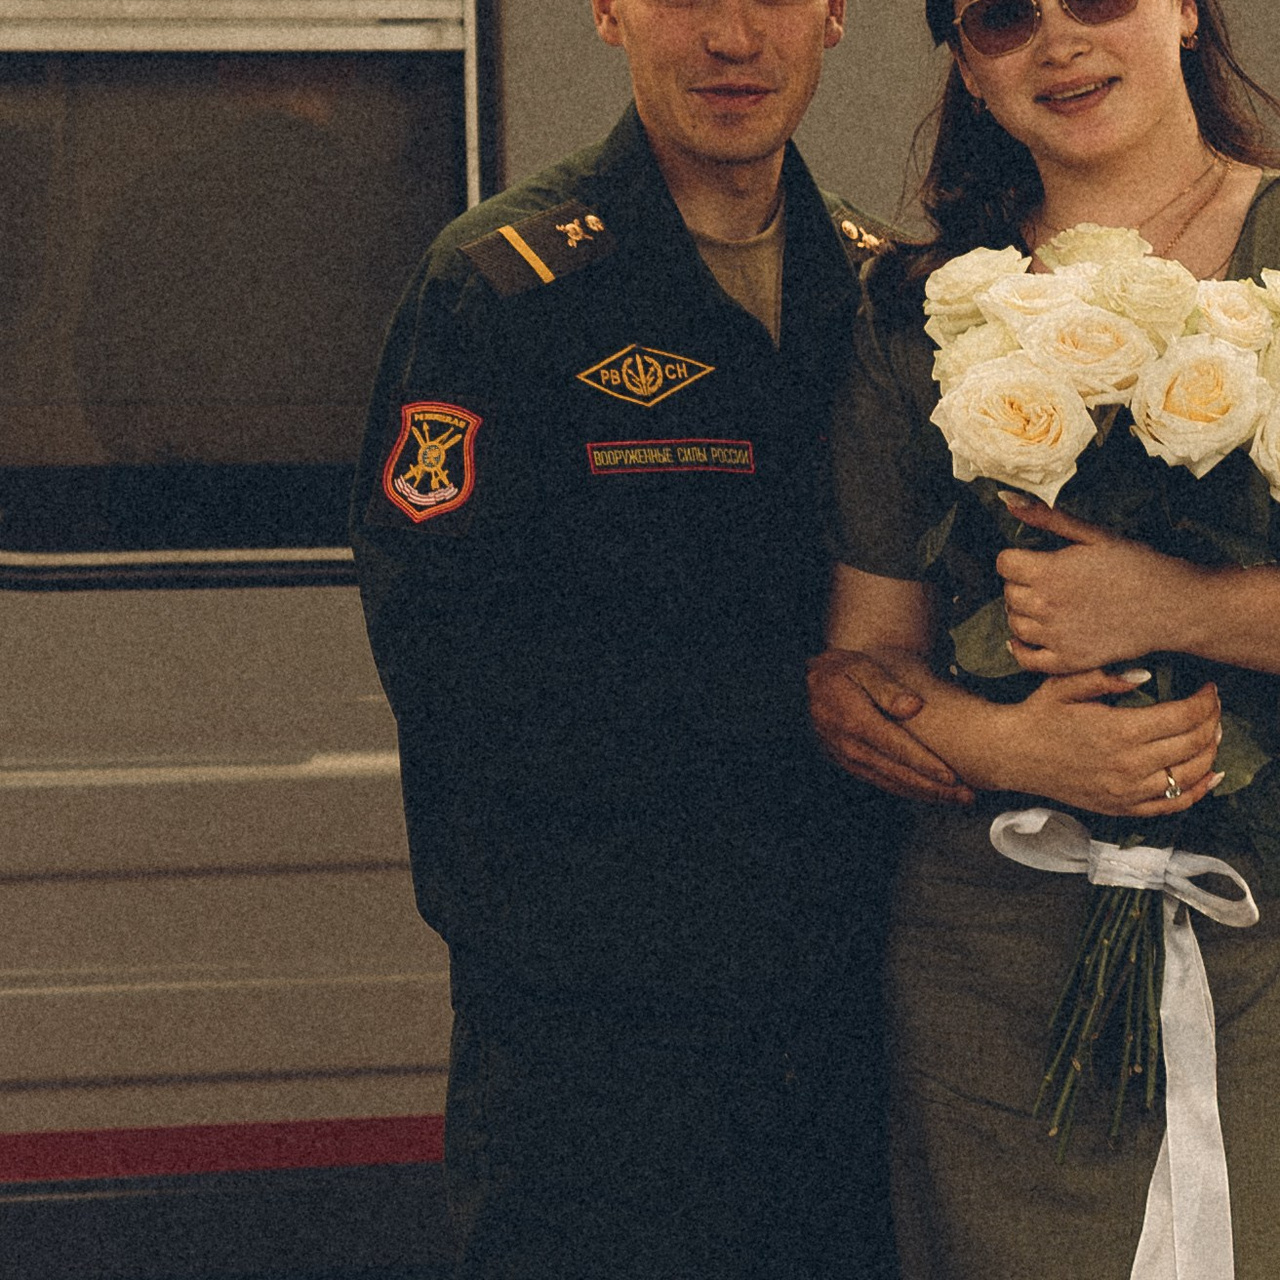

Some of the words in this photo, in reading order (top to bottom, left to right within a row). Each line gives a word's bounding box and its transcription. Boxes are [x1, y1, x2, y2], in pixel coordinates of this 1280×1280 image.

[600, 368, 621, 385] РВ
[664, 362, 688, 380] СН
[593, 448, 674, 467] ВООРУЖЕННЫЕ
[676, 446, 708, 462] СИЛЫ
[710, 447, 749, 465] РОССИИ
